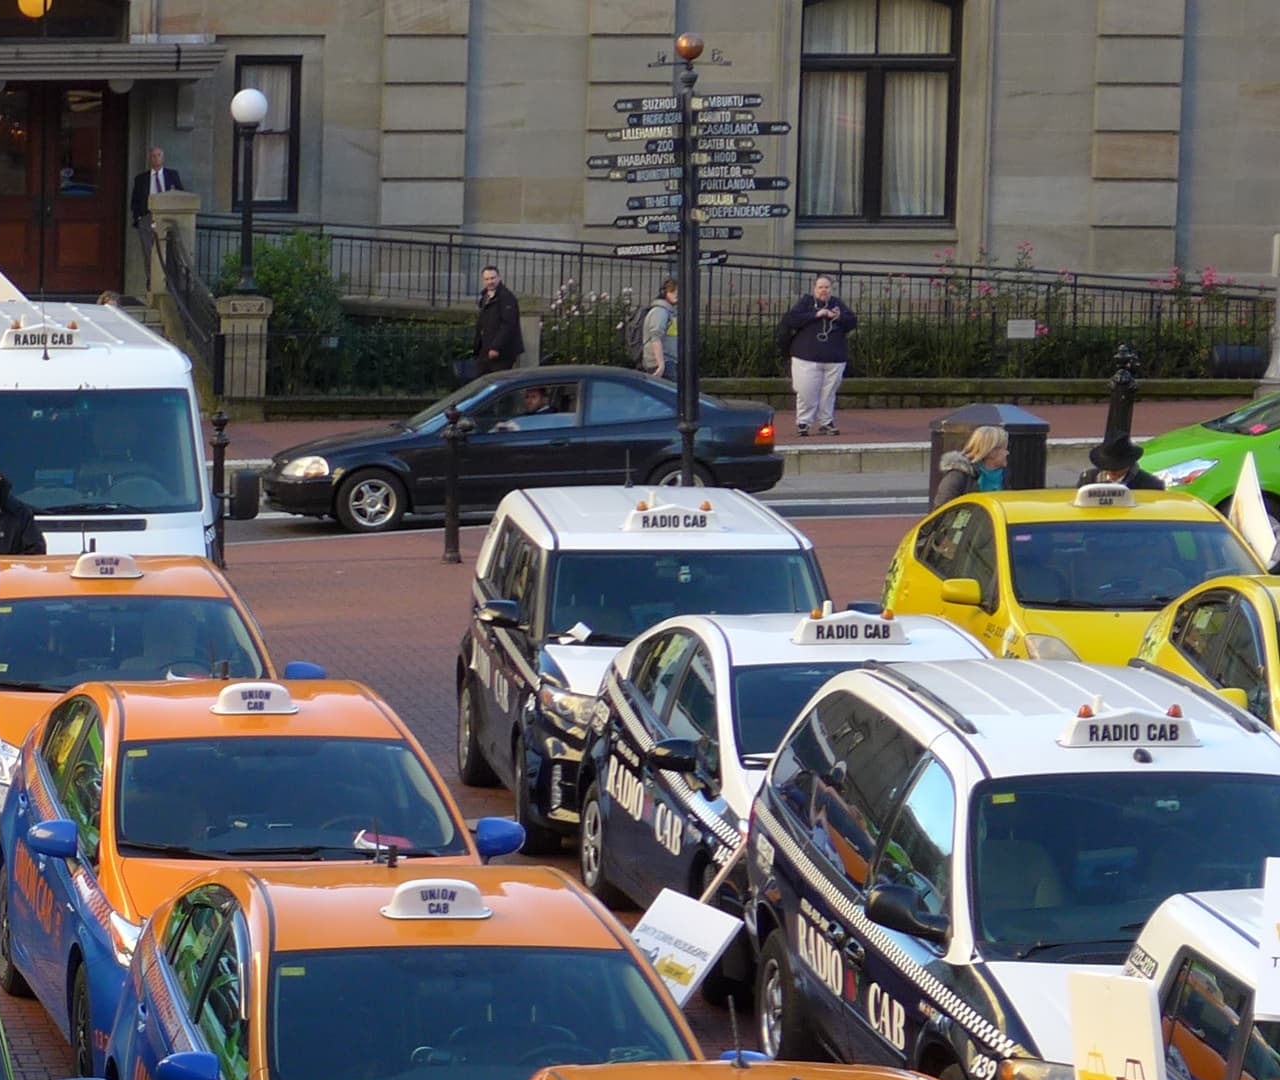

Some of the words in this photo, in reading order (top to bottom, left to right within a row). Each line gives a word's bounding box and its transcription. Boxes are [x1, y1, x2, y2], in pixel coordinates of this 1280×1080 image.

[642, 98, 677, 110] SUZHOU
[622, 126, 673, 140] LILLEHAMMER
[704, 123, 760, 135] CASABLANCA
[657, 140, 674, 152] ZOO
[617, 153, 675, 167] KHABAROVSK
[714, 152, 737, 163] HOOD
[700, 178, 756, 190] PORTLANDIA
[14, 333, 46, 345] RADIO
[51, 333, 74, 345] CAB
[642, 515, 680, 528] RADIO
[683, 515, 707, 528] CAB
[95, 556, 120, 566] UNION
[100, 566, 114, 575] CAB
[816, 624, 858, 639] RADIO
[864, 624, 890, 639] CAB
[241, 690, 272, 701] UNION
[247, 700, 265, 711] CAB
[1089, 724, 1139, 742] RADIO
[1146, 724, 1180, 741] CAB
[606, 754, 644, 821] RADIO
[655, 802, 682, 856] CAB
[420, 888, 458, 902] UNION
[428, 902, 450, 914] CAB
[798, 913, 843, 996] RADIO
[868, 982, 905, 1051] CAB
[970, 1054, 997, 1080] 139
